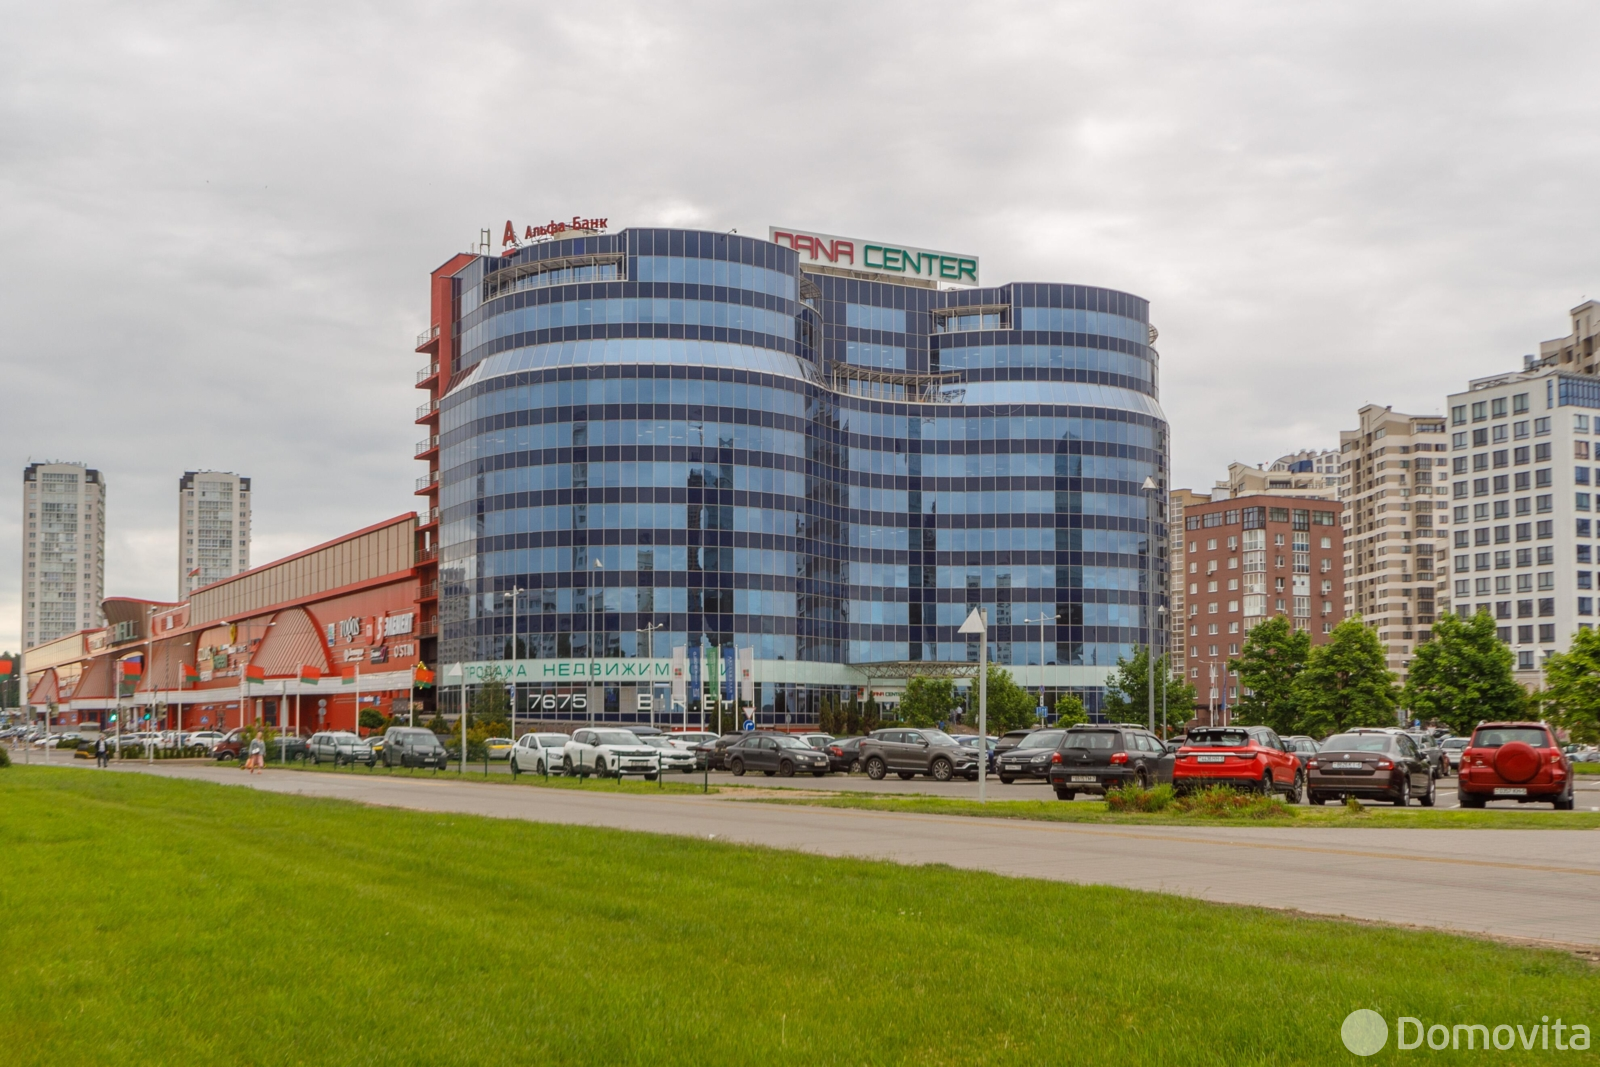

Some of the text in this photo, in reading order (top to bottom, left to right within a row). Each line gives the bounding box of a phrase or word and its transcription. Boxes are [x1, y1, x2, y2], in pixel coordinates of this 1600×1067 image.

[524, 216, 608, 239] Альфа-Банк
[864, 244, 977, 281] CENTER
[528, 694, 587, 709] 7675
